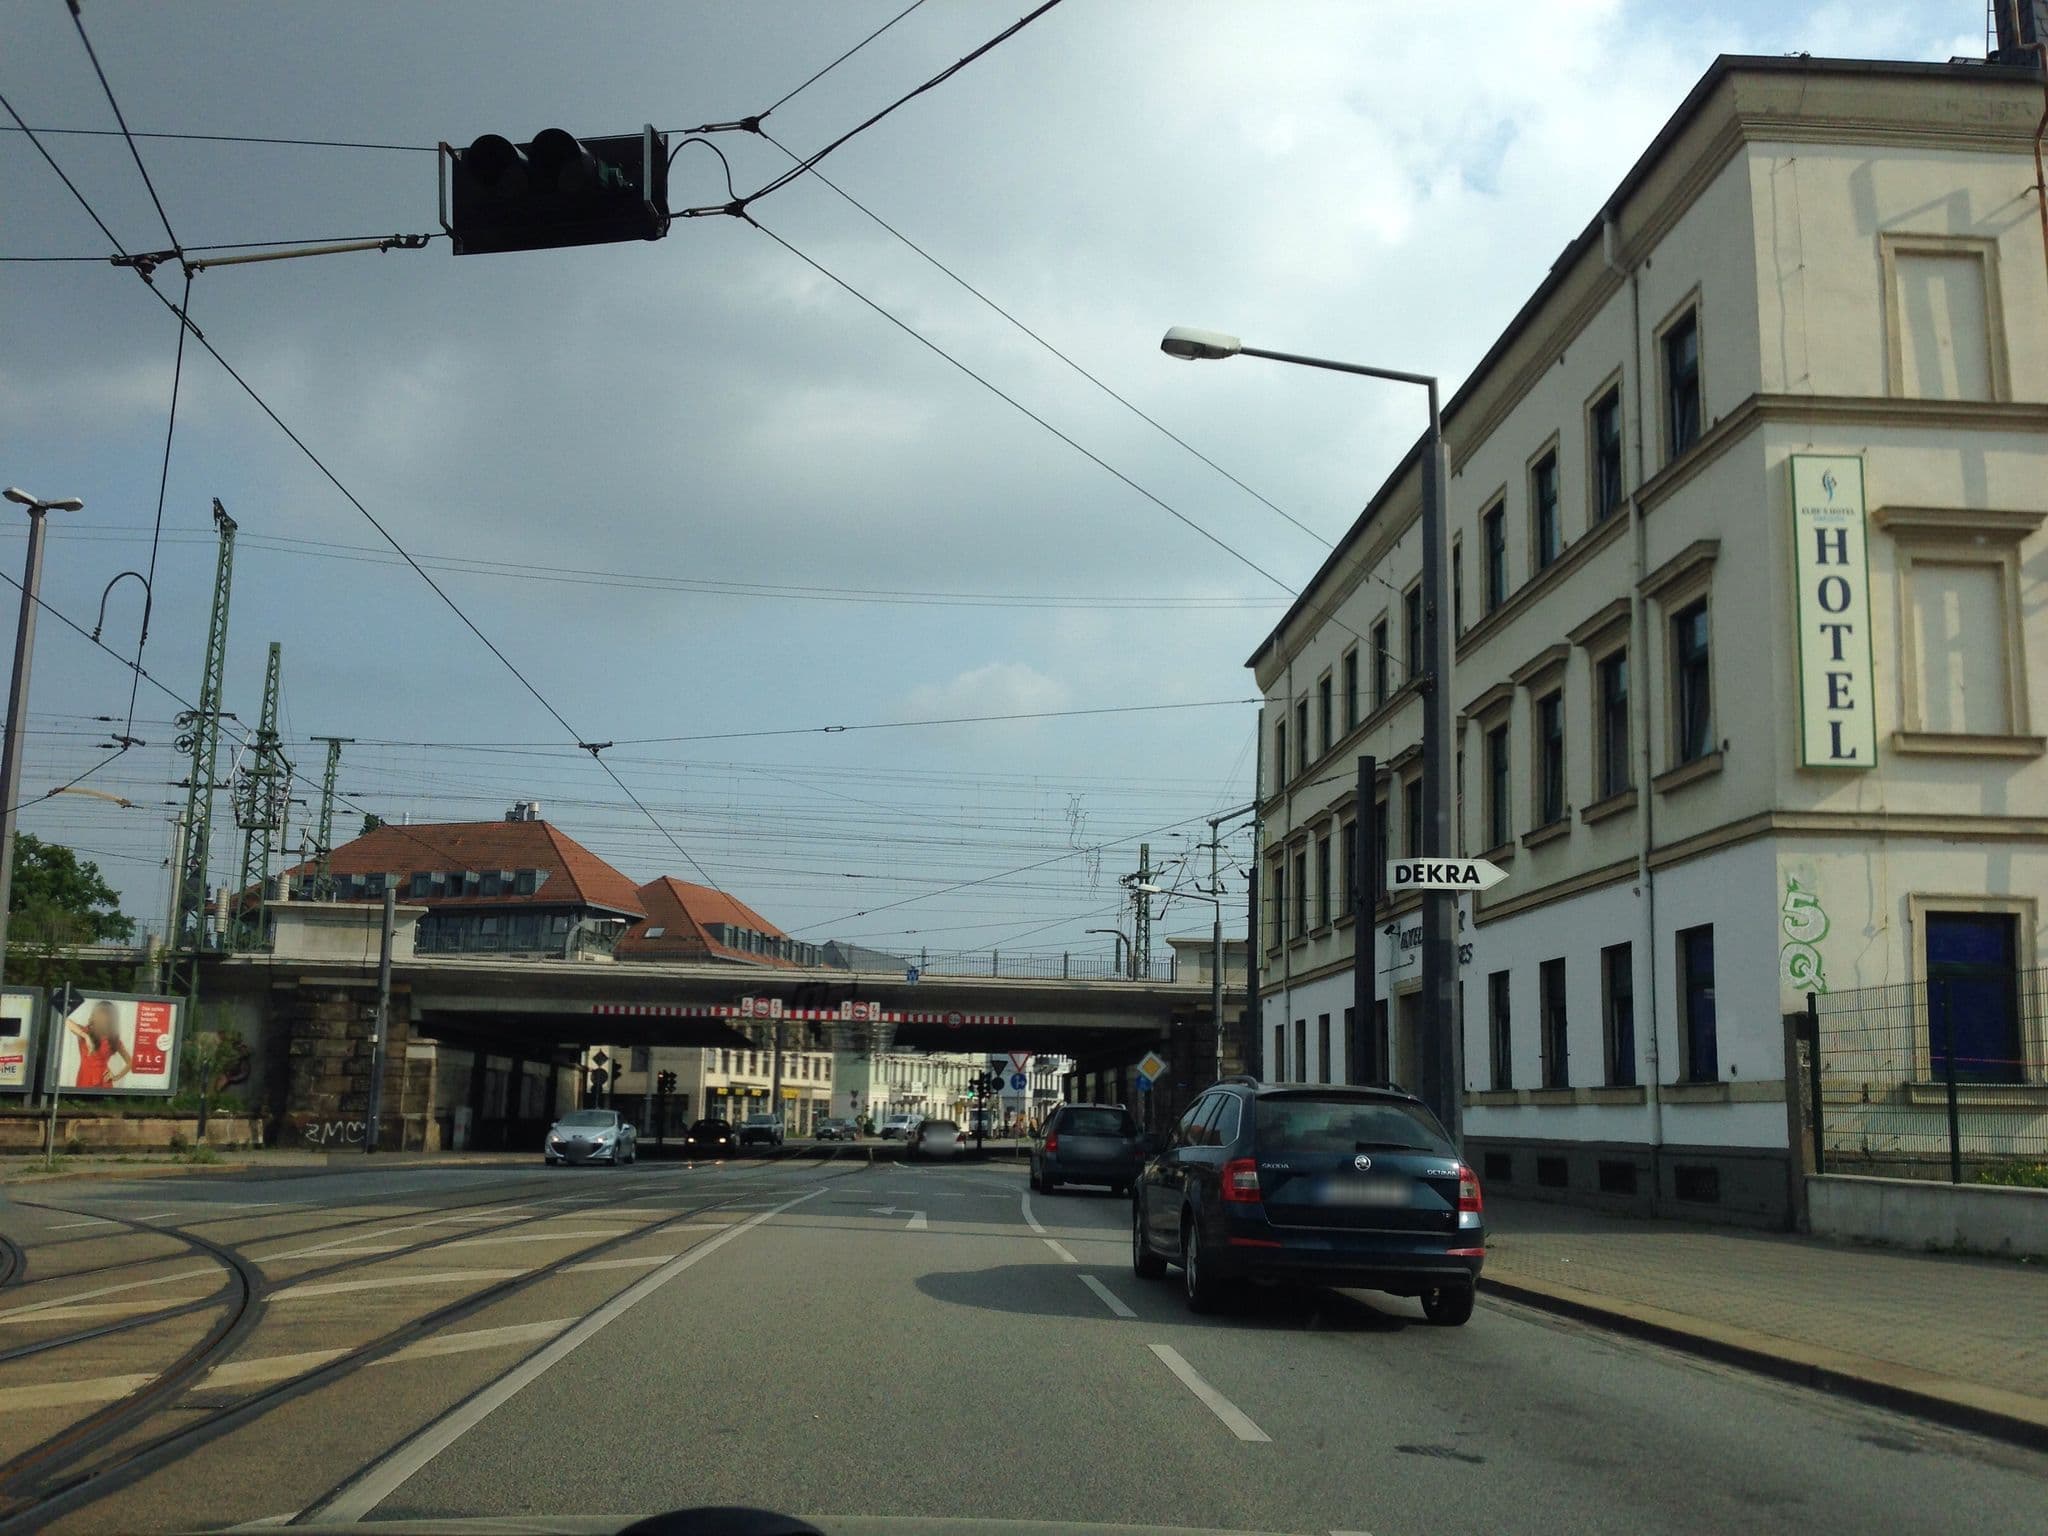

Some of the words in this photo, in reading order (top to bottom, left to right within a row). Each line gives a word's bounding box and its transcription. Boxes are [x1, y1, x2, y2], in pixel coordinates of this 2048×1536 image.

[1814, 527, 1857, 760] HOTEL
[1395, 863, 1480, 884] DEKRA
[137, 1054, 161, 1063] TLC
